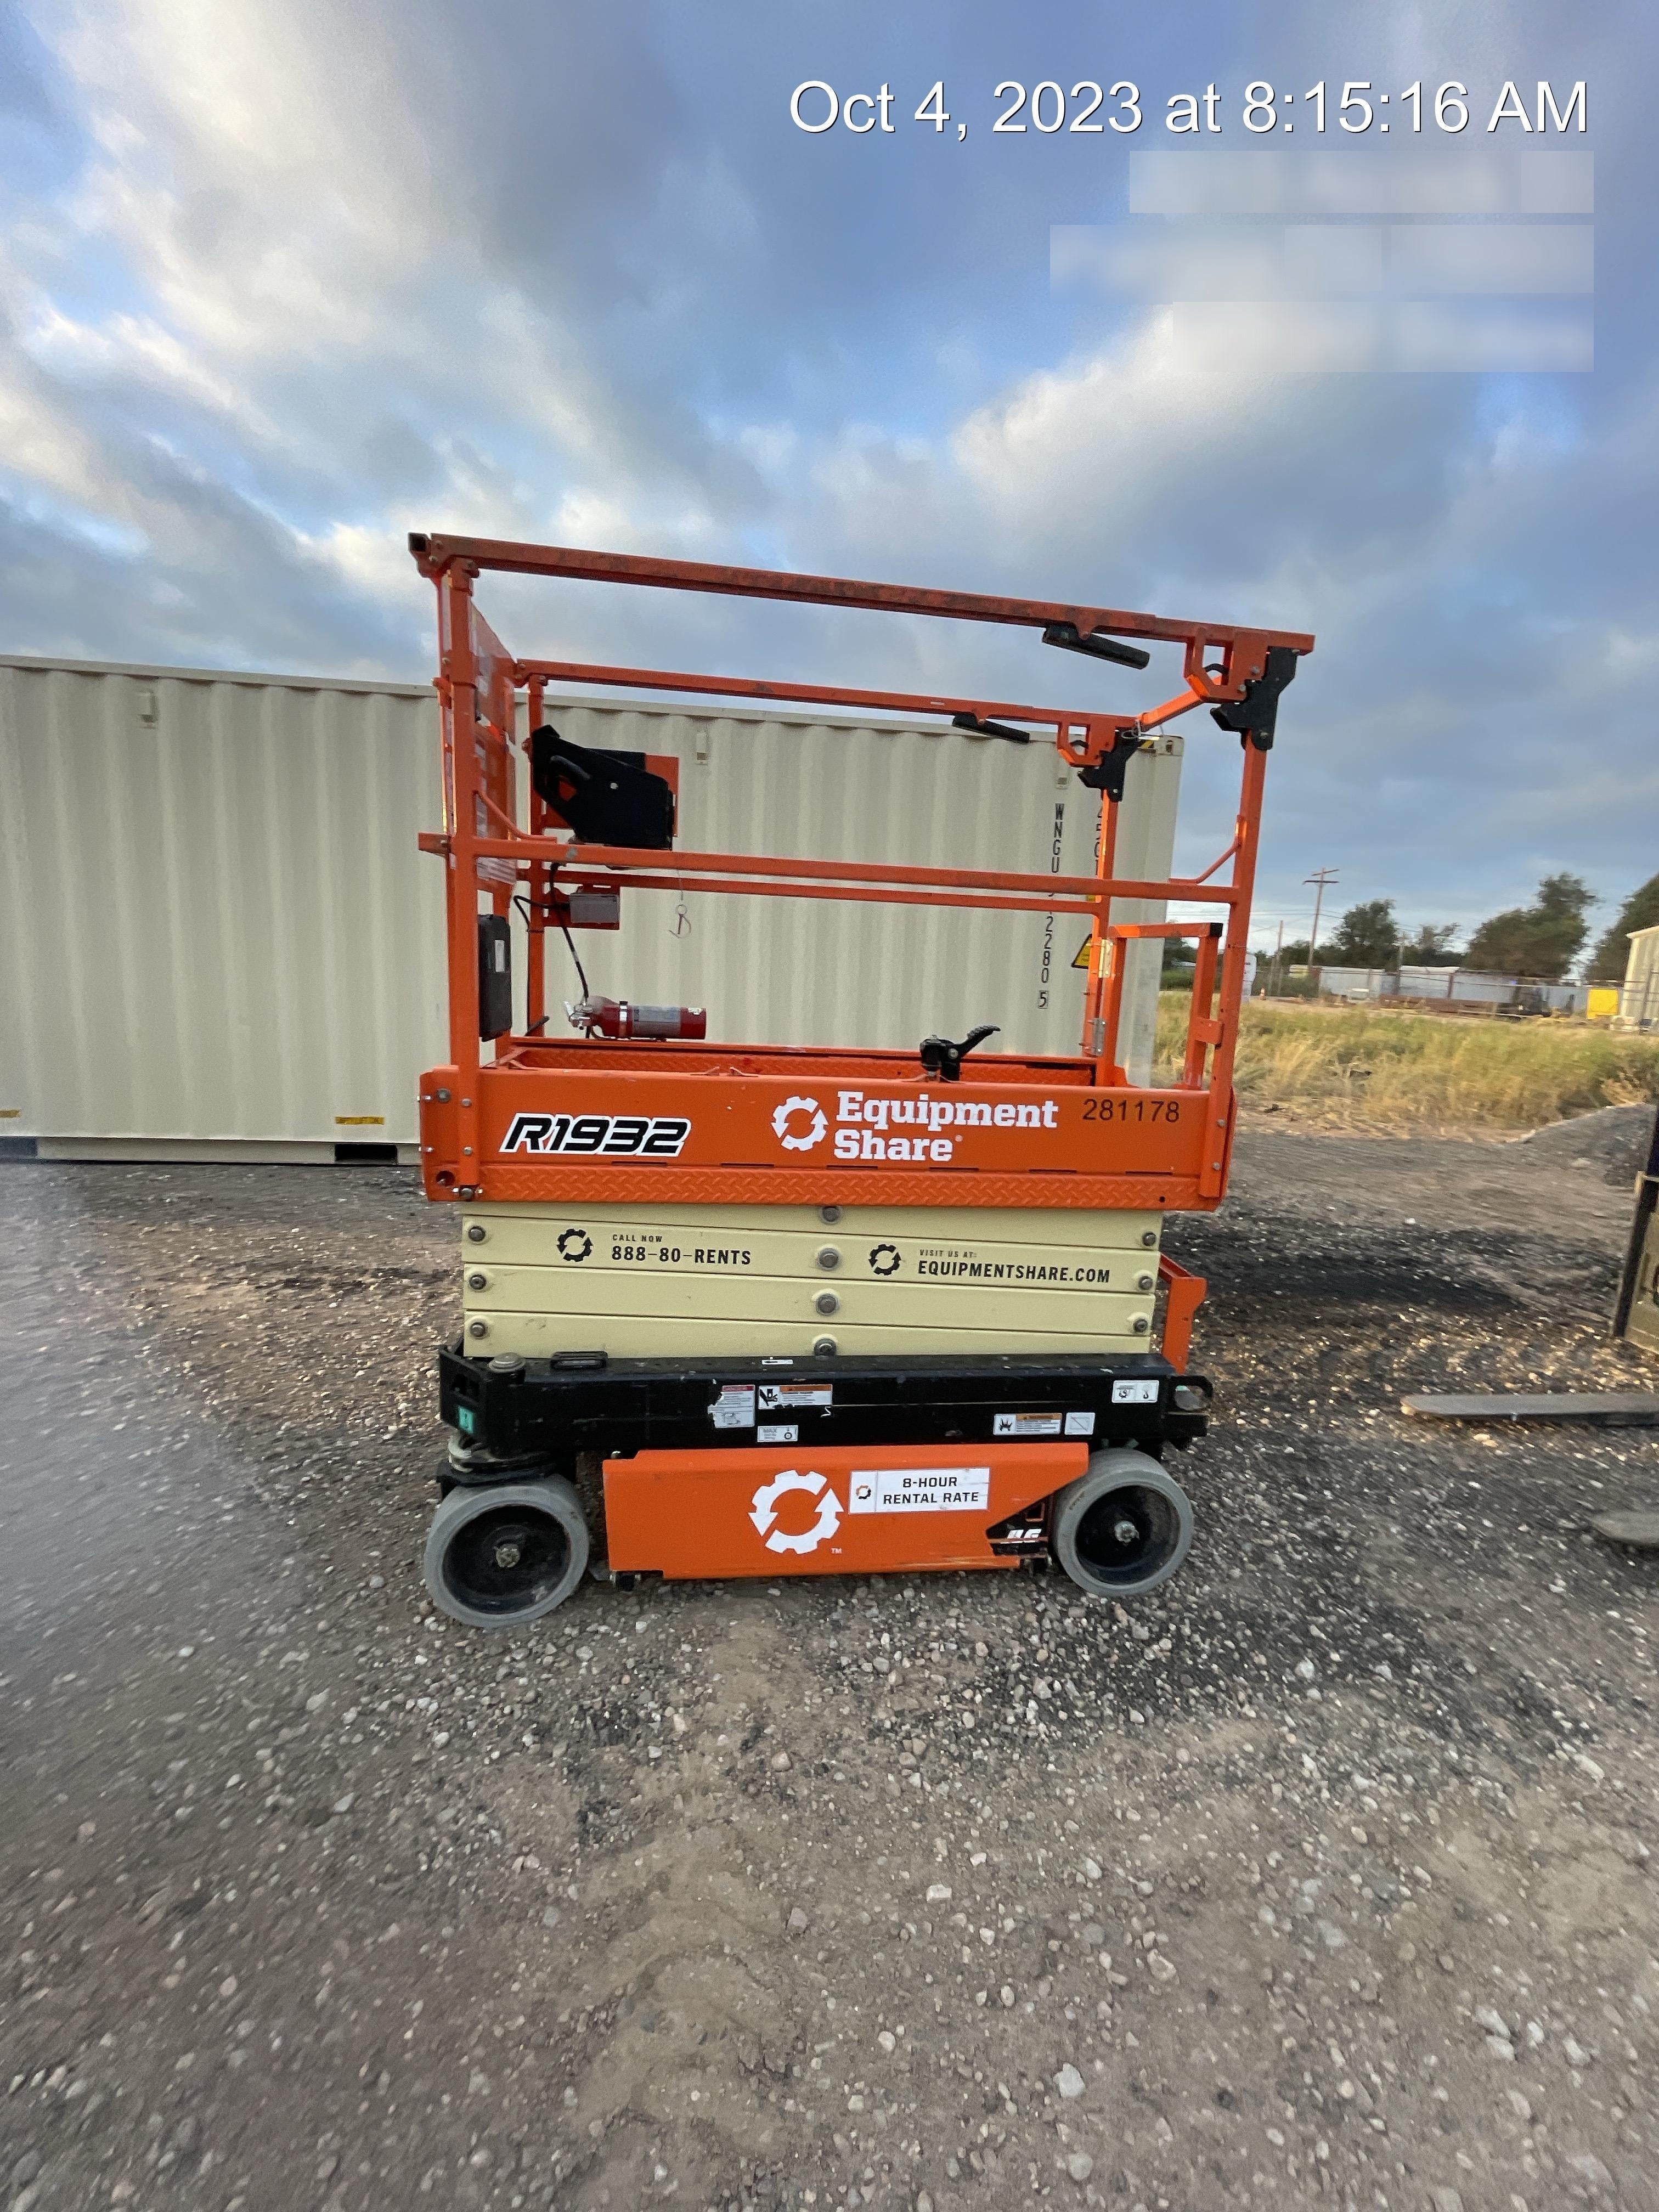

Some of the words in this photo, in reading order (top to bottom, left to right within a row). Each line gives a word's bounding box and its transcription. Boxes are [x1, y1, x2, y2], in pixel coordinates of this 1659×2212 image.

[1051, 803, 1064, 873] WNGU
[1039, 991, 1047, 1007] 5
[836, 1091, 1059, 1132] Equipment
[1082, 1098, 1180, 1122] 281178
[498, 1113, 691, 1156] R1932
[834, 1129, 953, 1161] Share
[612, 1245, 752, 1265] 888-80-RENTS
[918, 1260, 1110, 1283] EQUIPMENTSHARE.COM
[902, 1477, 958, 1488] 8-HOUR
[883, 1493, 938, 1505] RENTAL
[943, 1492, 979, 1503] RATE
